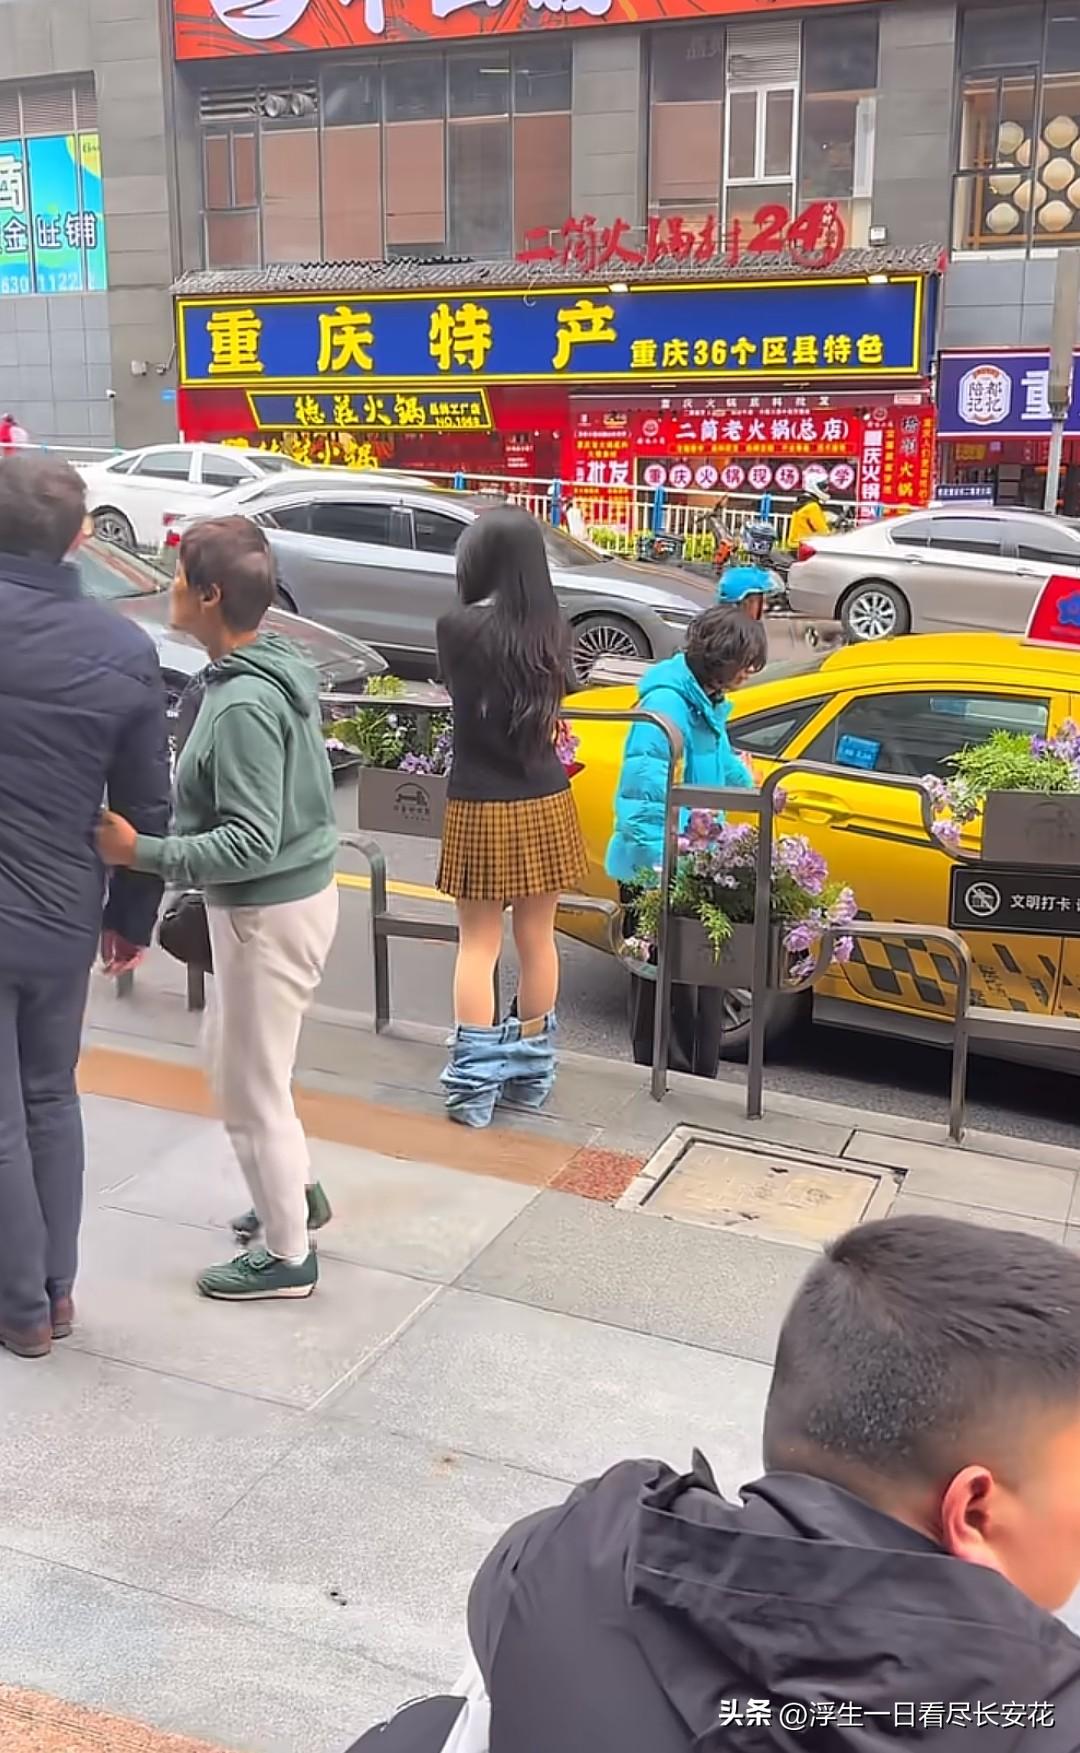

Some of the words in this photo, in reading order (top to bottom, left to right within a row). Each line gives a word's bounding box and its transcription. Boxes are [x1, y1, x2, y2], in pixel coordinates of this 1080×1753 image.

[0, 212, 97, 253] 金旺铺
[206, 300, 617, 374] 重庆特产
[630, 334, 885, 368] 重庆36个区县特色
[675, 418, 849, 442] 二筒老火锅(总店)
[648, 466, 850, 486] 重庆火锅现场学
[1010, 894, 1071, 911] 文明打卡
